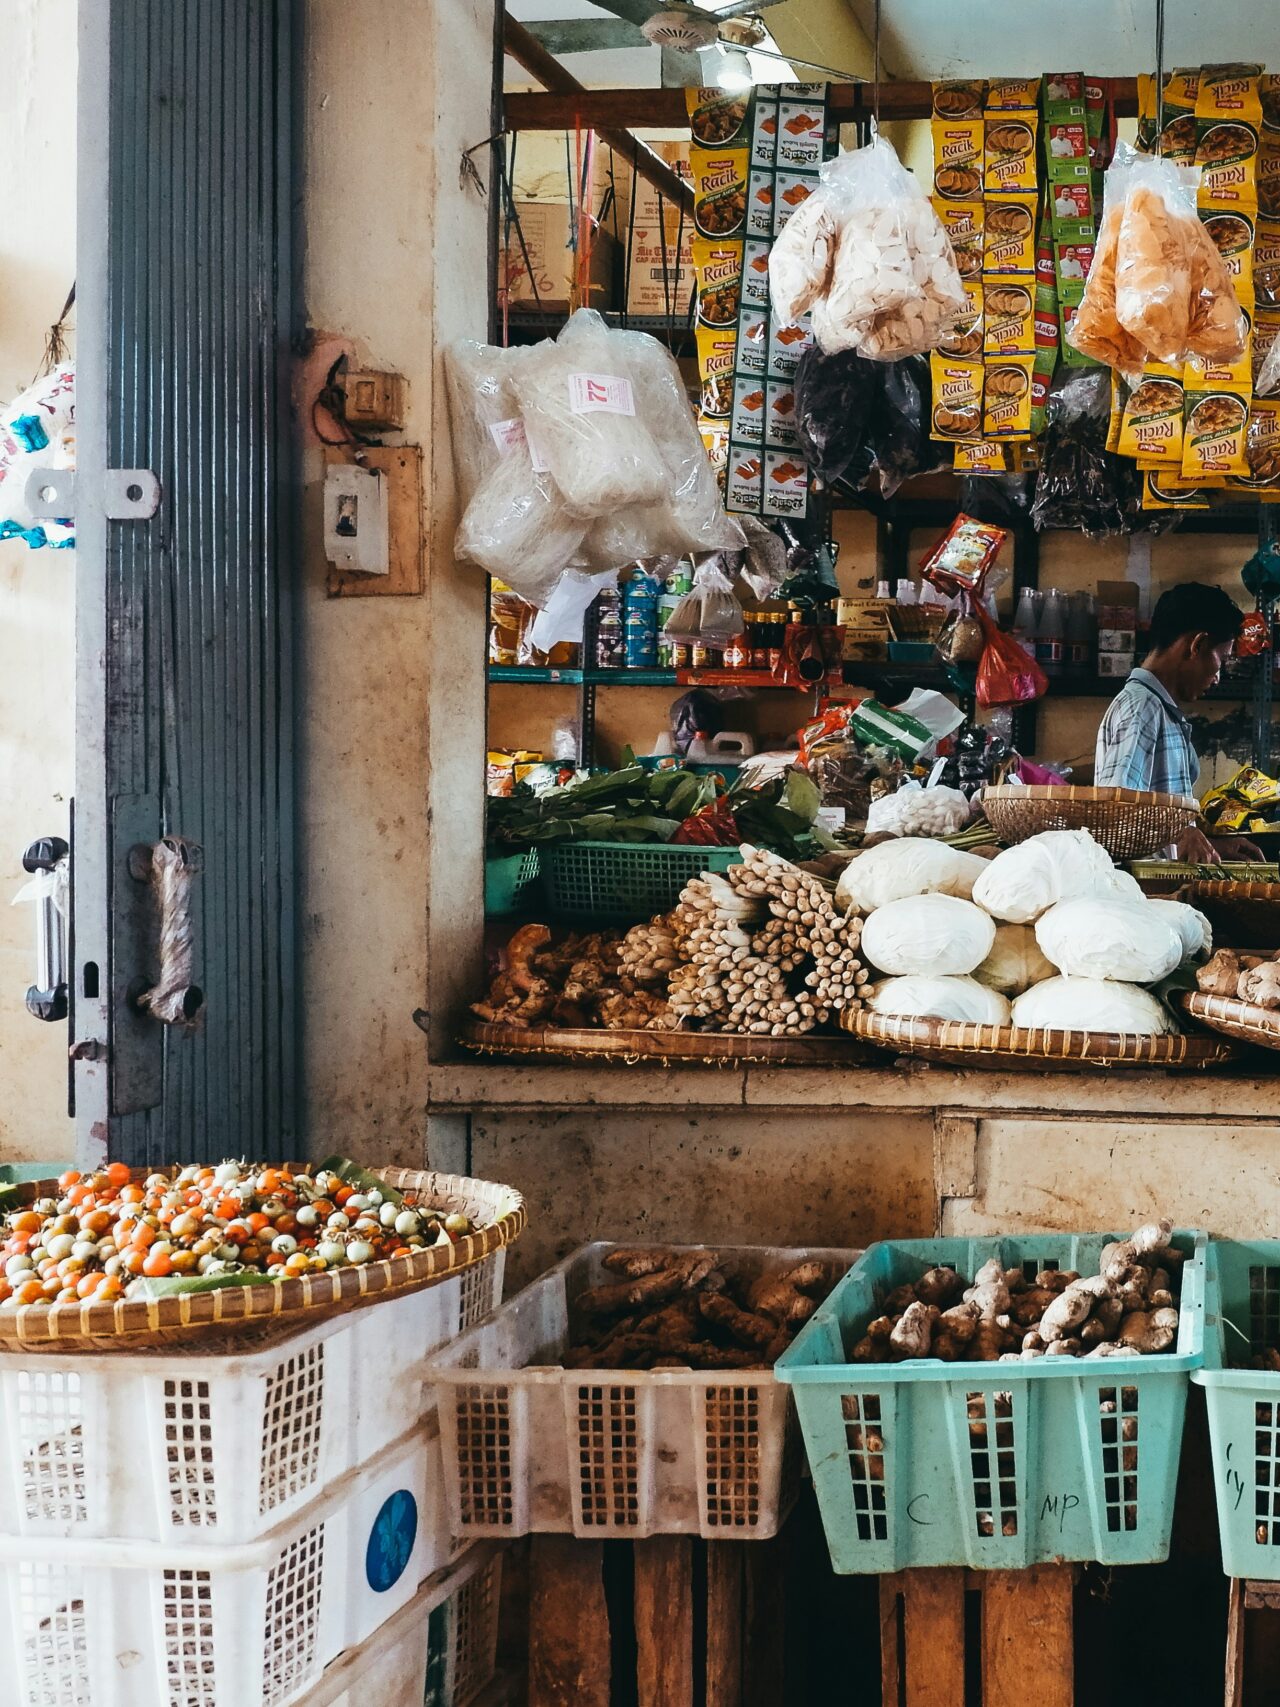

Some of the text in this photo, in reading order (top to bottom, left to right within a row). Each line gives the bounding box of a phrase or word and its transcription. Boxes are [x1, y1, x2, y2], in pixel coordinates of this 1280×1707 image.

[1212, 80, 1250, 99] Racik
[782, 147, 818, 163] Desaku
[941, 138, 975, 159] Racik
[701, 168, 738, 192] Racik
[994, 161, 1027, 182] Racik
[1208, 166, 1246, 190] Racik
[993, 241, 1025, 262] Racik
[703, 260, 741, 282] Racik
[992, 323, 1025, 345] Racik
[706, 350, 734, 373] Raci
[586, 379, 608, 402] 77
[941, 379, 975, 398] Racik
[990, 403, 1020, 424] Racik
[1134, 421, 1174, 442] Racik
[965, 443, 998, 462] Racik
[1197, 439, 1237, 461] Racik
[769, 496, 800, 510] Desaku
[1243, 623, 1263, 636] ABC
[906, 1493, 934, 1526] C
[1040, 1493, 1080, 1533] MP
